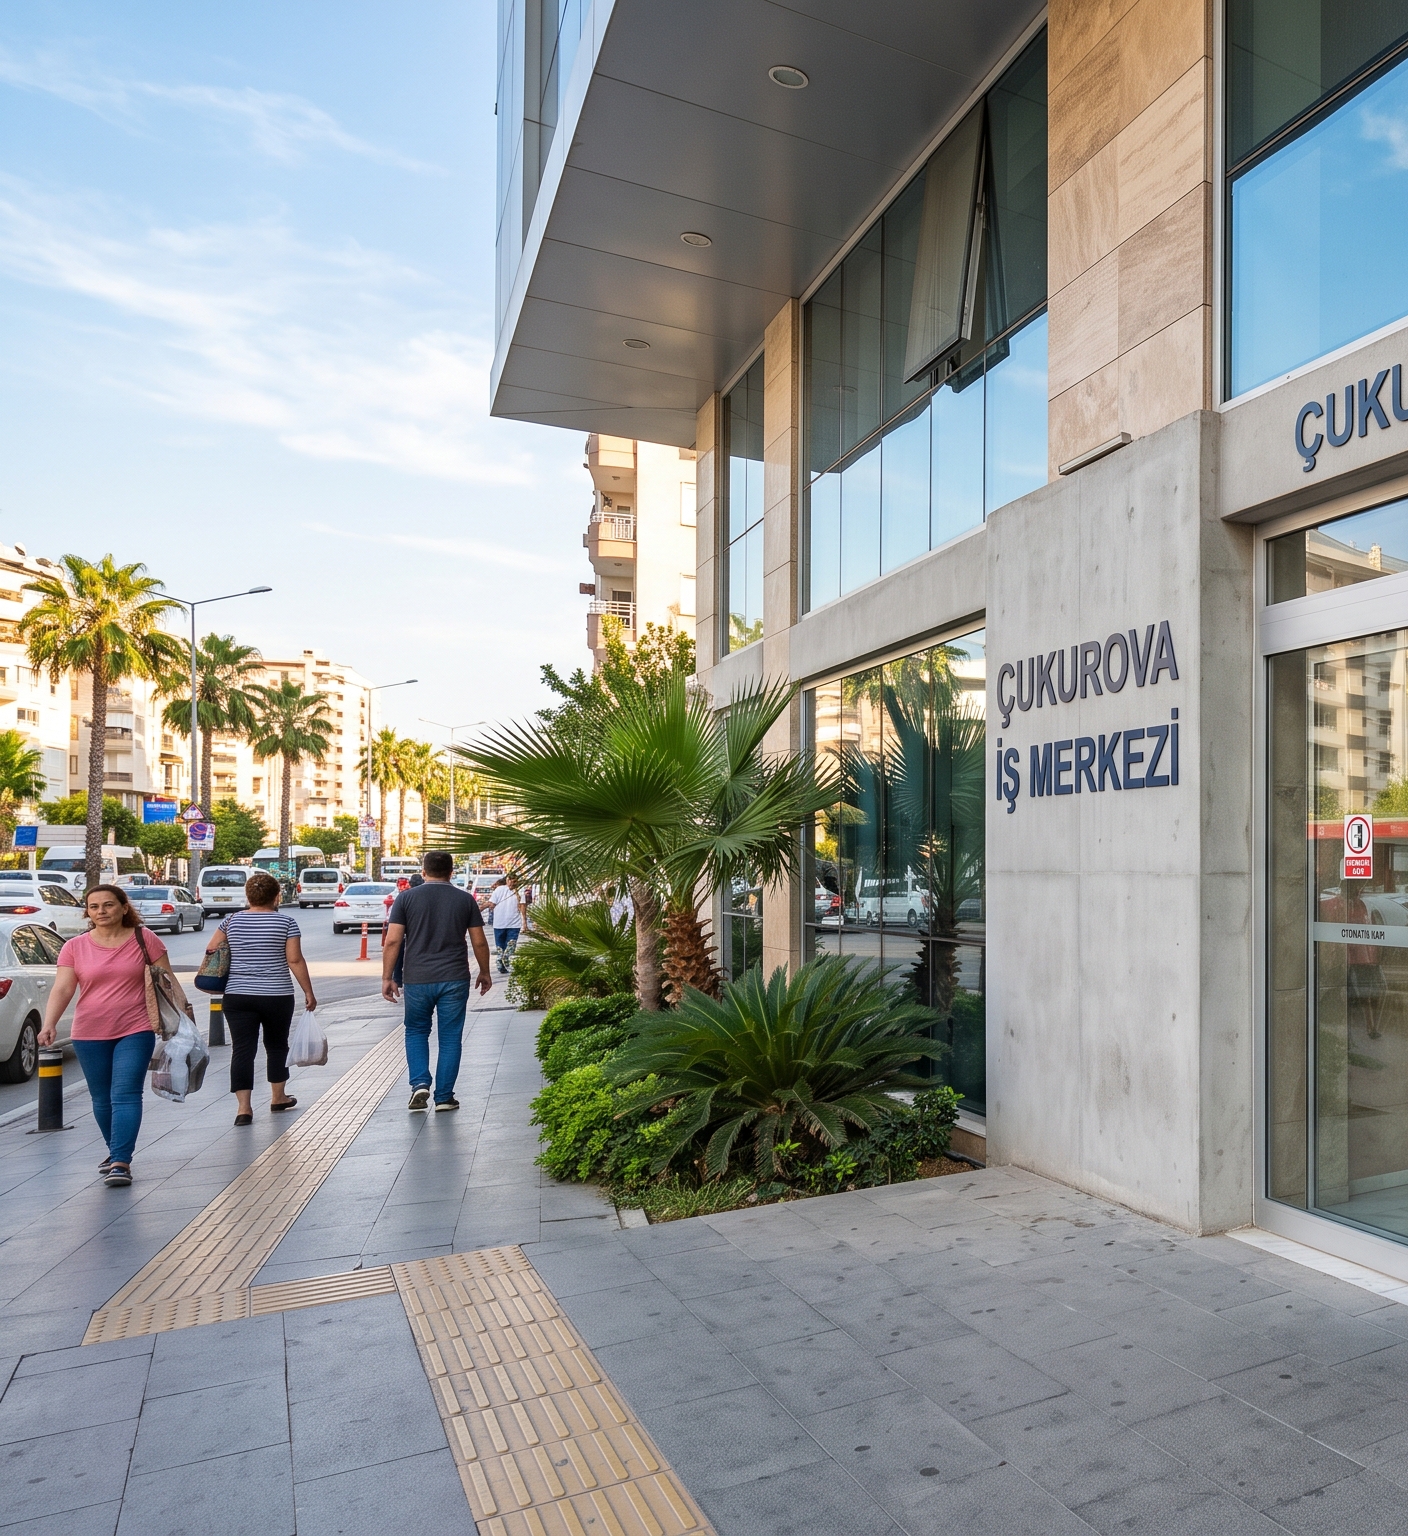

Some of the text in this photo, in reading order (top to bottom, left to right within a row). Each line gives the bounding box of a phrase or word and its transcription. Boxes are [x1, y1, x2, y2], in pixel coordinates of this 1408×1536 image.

[996, 620, 1179, 729] ÇUKUROVA
[996, 707, 1179, 814] İŞ MERKEZİ
